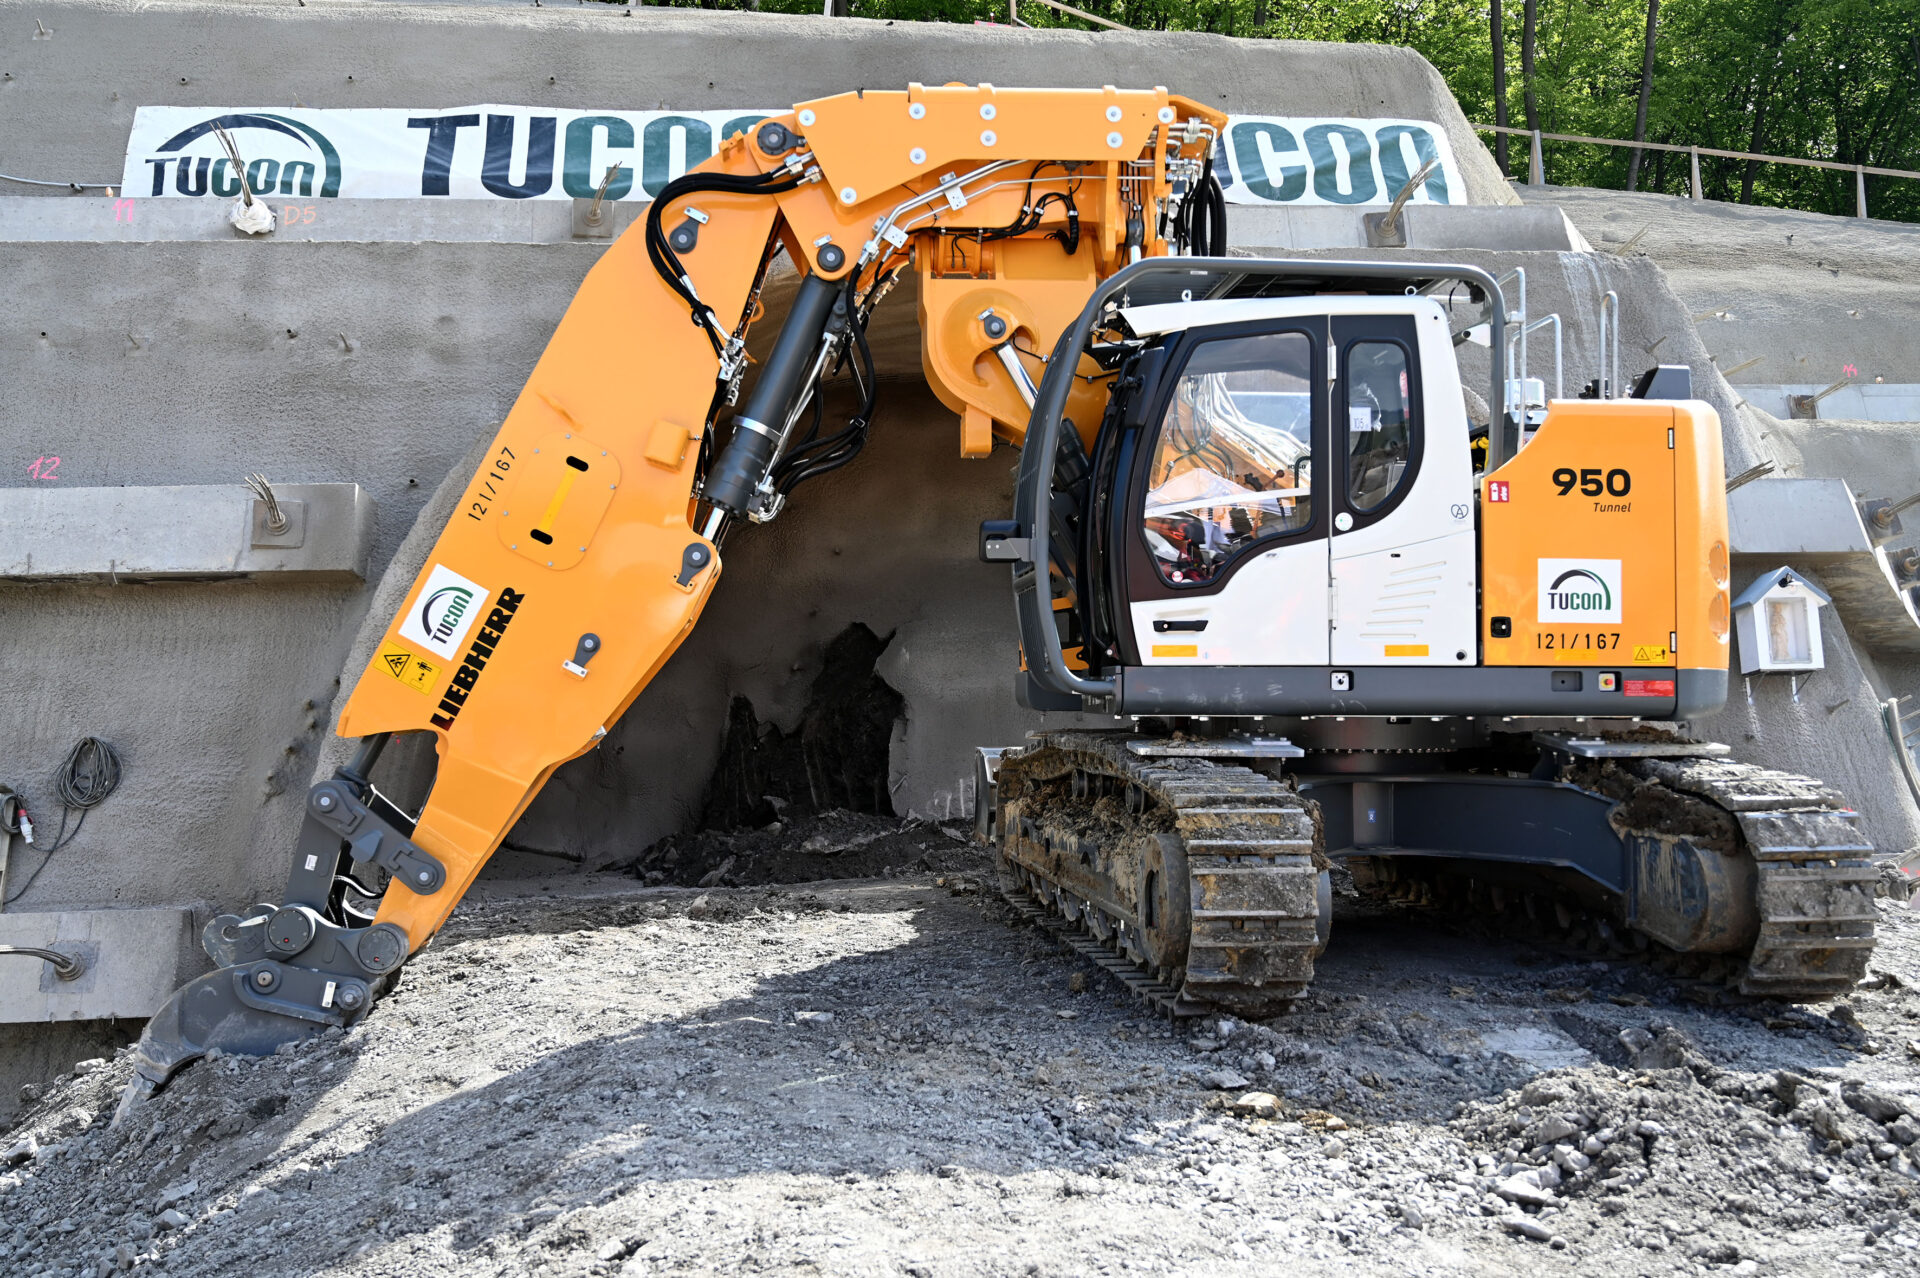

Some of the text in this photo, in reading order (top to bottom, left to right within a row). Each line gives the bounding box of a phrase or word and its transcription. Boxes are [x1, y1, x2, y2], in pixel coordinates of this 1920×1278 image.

[407, 114, 772, 200] TUCO
[1212, 122, 1449, 204] CON
[145, 156, 315, 197] TUCON
[112, 199, 135, 222] 11
[284, 206, 316, 225] D5
[27, 456, 60, 480] 12
[1552, 467, 1631, 497] 950
[468, 446, 515, 521] 121/167
[1593, 502, 1631, 512] Tunnel
[1547, 592, 1602, 610] TUCON
[431, 595, 470, 644] TUCON
[1537, 633, 1620, 649] 121/167
[429, 587, 526, 731] LIEBHERR
